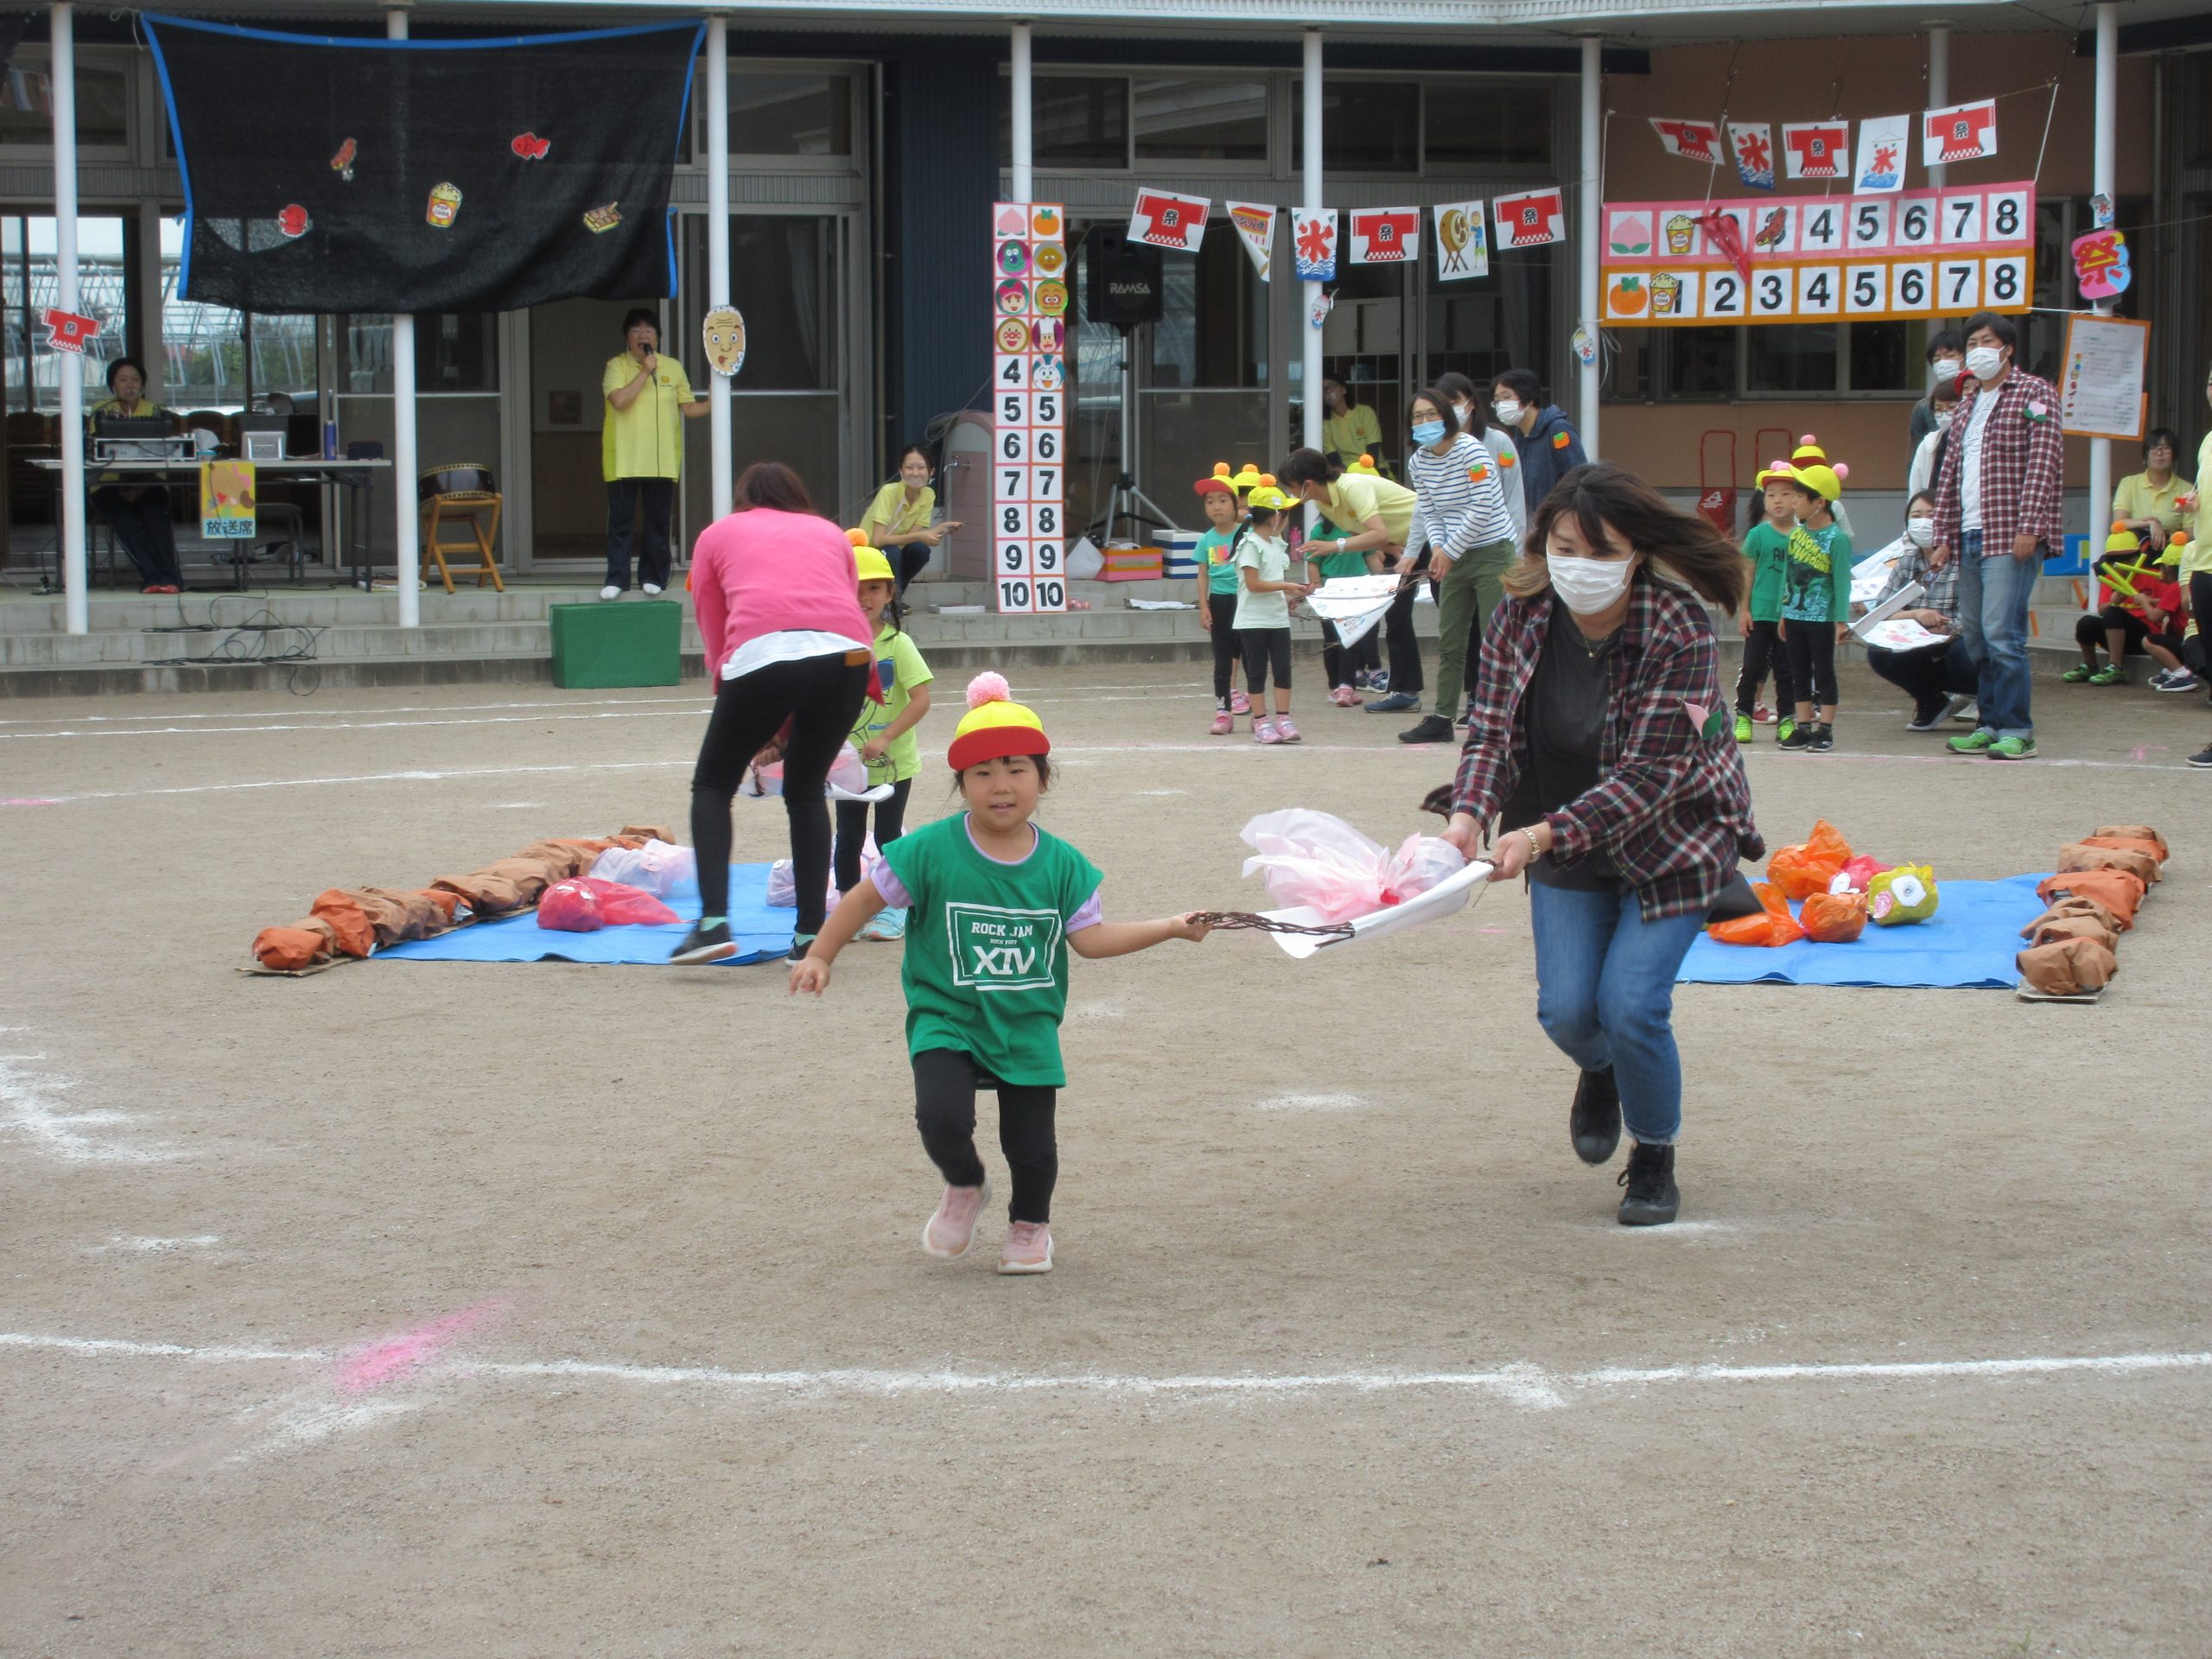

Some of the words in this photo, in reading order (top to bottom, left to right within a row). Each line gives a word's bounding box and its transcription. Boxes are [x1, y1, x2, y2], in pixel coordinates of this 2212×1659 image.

[1955, 121, 1969, 139] 祭
[1737, 132, 1770, 174] 氷
[1811, 138, 1825, 157] 祭
[1871, 146, 1898, 175] 氷
[1162, 208, 1179, 226] 祭
[1523, 207, 1538, 226] 祭
[1809, 208, 1834, 244] 4
[1856, 205, 1879, 241] 5
[1904, 205, 1928, 241] 6
[1952, 201, 1974, 238] 7
[1995, 199, 2019, 235] 8
[1296, 219, 1334, 264] 氷
[1377, 223, 1394, 241] 祭
[2074, 235, 2124, 288] 祭
[1109, 282, 1151, 294] RAMSA
[1713, 276, 1737, 312] 2
[1759, 275, 1783, 310] 3
[1806, 272, 1831, 308] 4
[1853, 271, 1877, 308] 5
[1901, 269, 1924, 305] 6
[1948, 266, 1972, 303] 7
[1993, 264, 2017, 300] 8
[1003, 358, 1021, 384] 4
[1004, 396, 1021, 422] 5
[1039, 396, 1056, 422] 5
[1004, 432, 1021, 459] 6
[1039, 432, 1056, 459] 6
[1004, 471, 1021, 496] 7
[1039, 470, 1055, 495] 7
[206, 520, 254, 536] 放送席
[1004, 507, 1021, 533] 8
[1039, 507, 1056, 533] 8
[1005, 544, 1022, 570] 9
[1039, 543, 1056, 569] 9
[1001, 582, 1030, 607] 10
[1036, 582, 1065, 607] 10
[971, 921, 1007, 937] ROCK
[1009, 925, 1033, 938] JAM
[971, 945, 1036, 976] XIV
